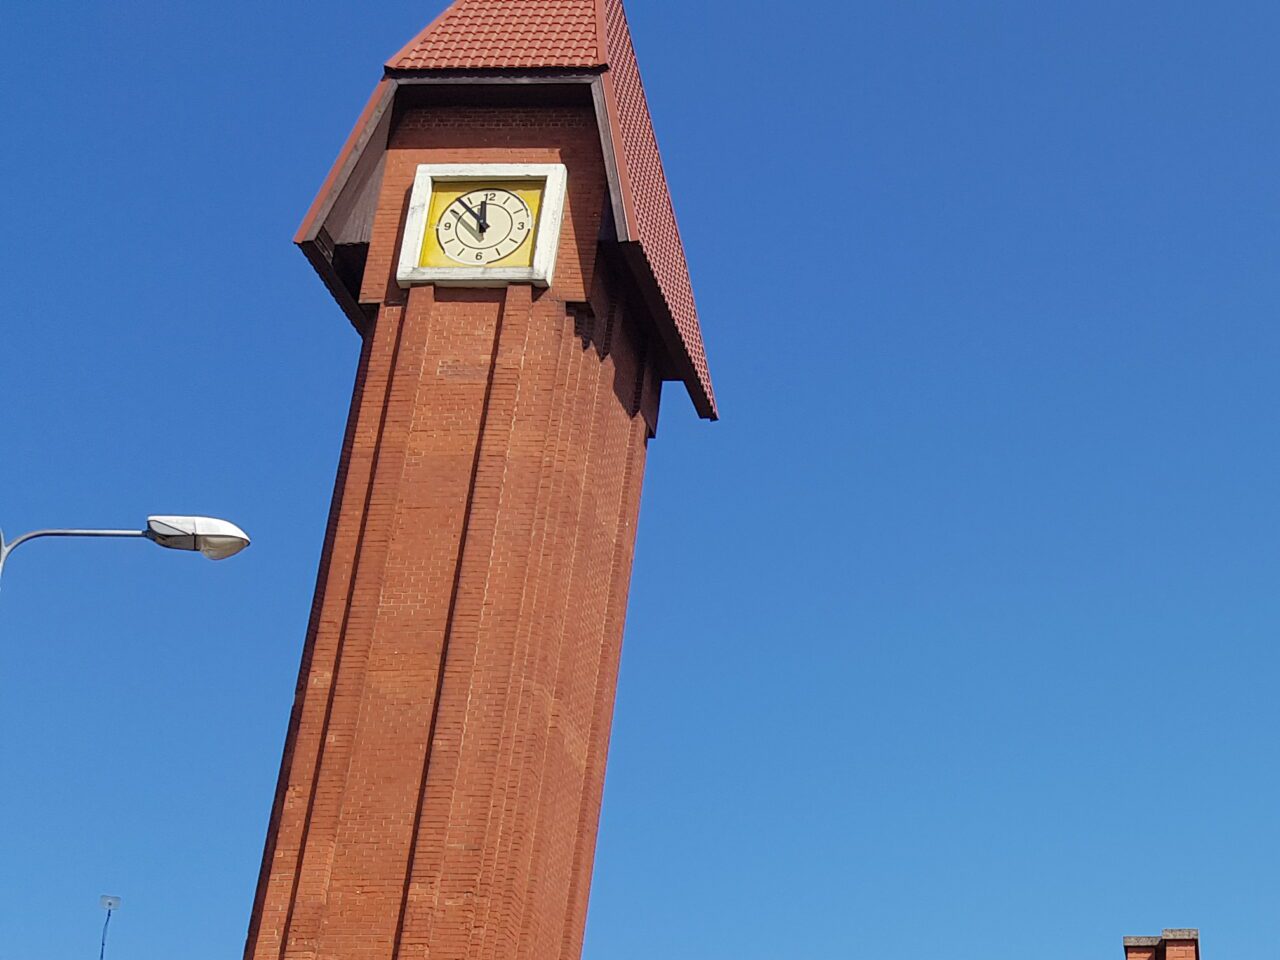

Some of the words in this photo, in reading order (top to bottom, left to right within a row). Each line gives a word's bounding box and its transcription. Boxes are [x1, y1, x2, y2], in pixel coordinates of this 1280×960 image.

[484, 193, 496, 201] 12
[444, 222, 451, 230] 9
[517, 222, 524, 230] 3
[475, 252, 483, 260] 6
